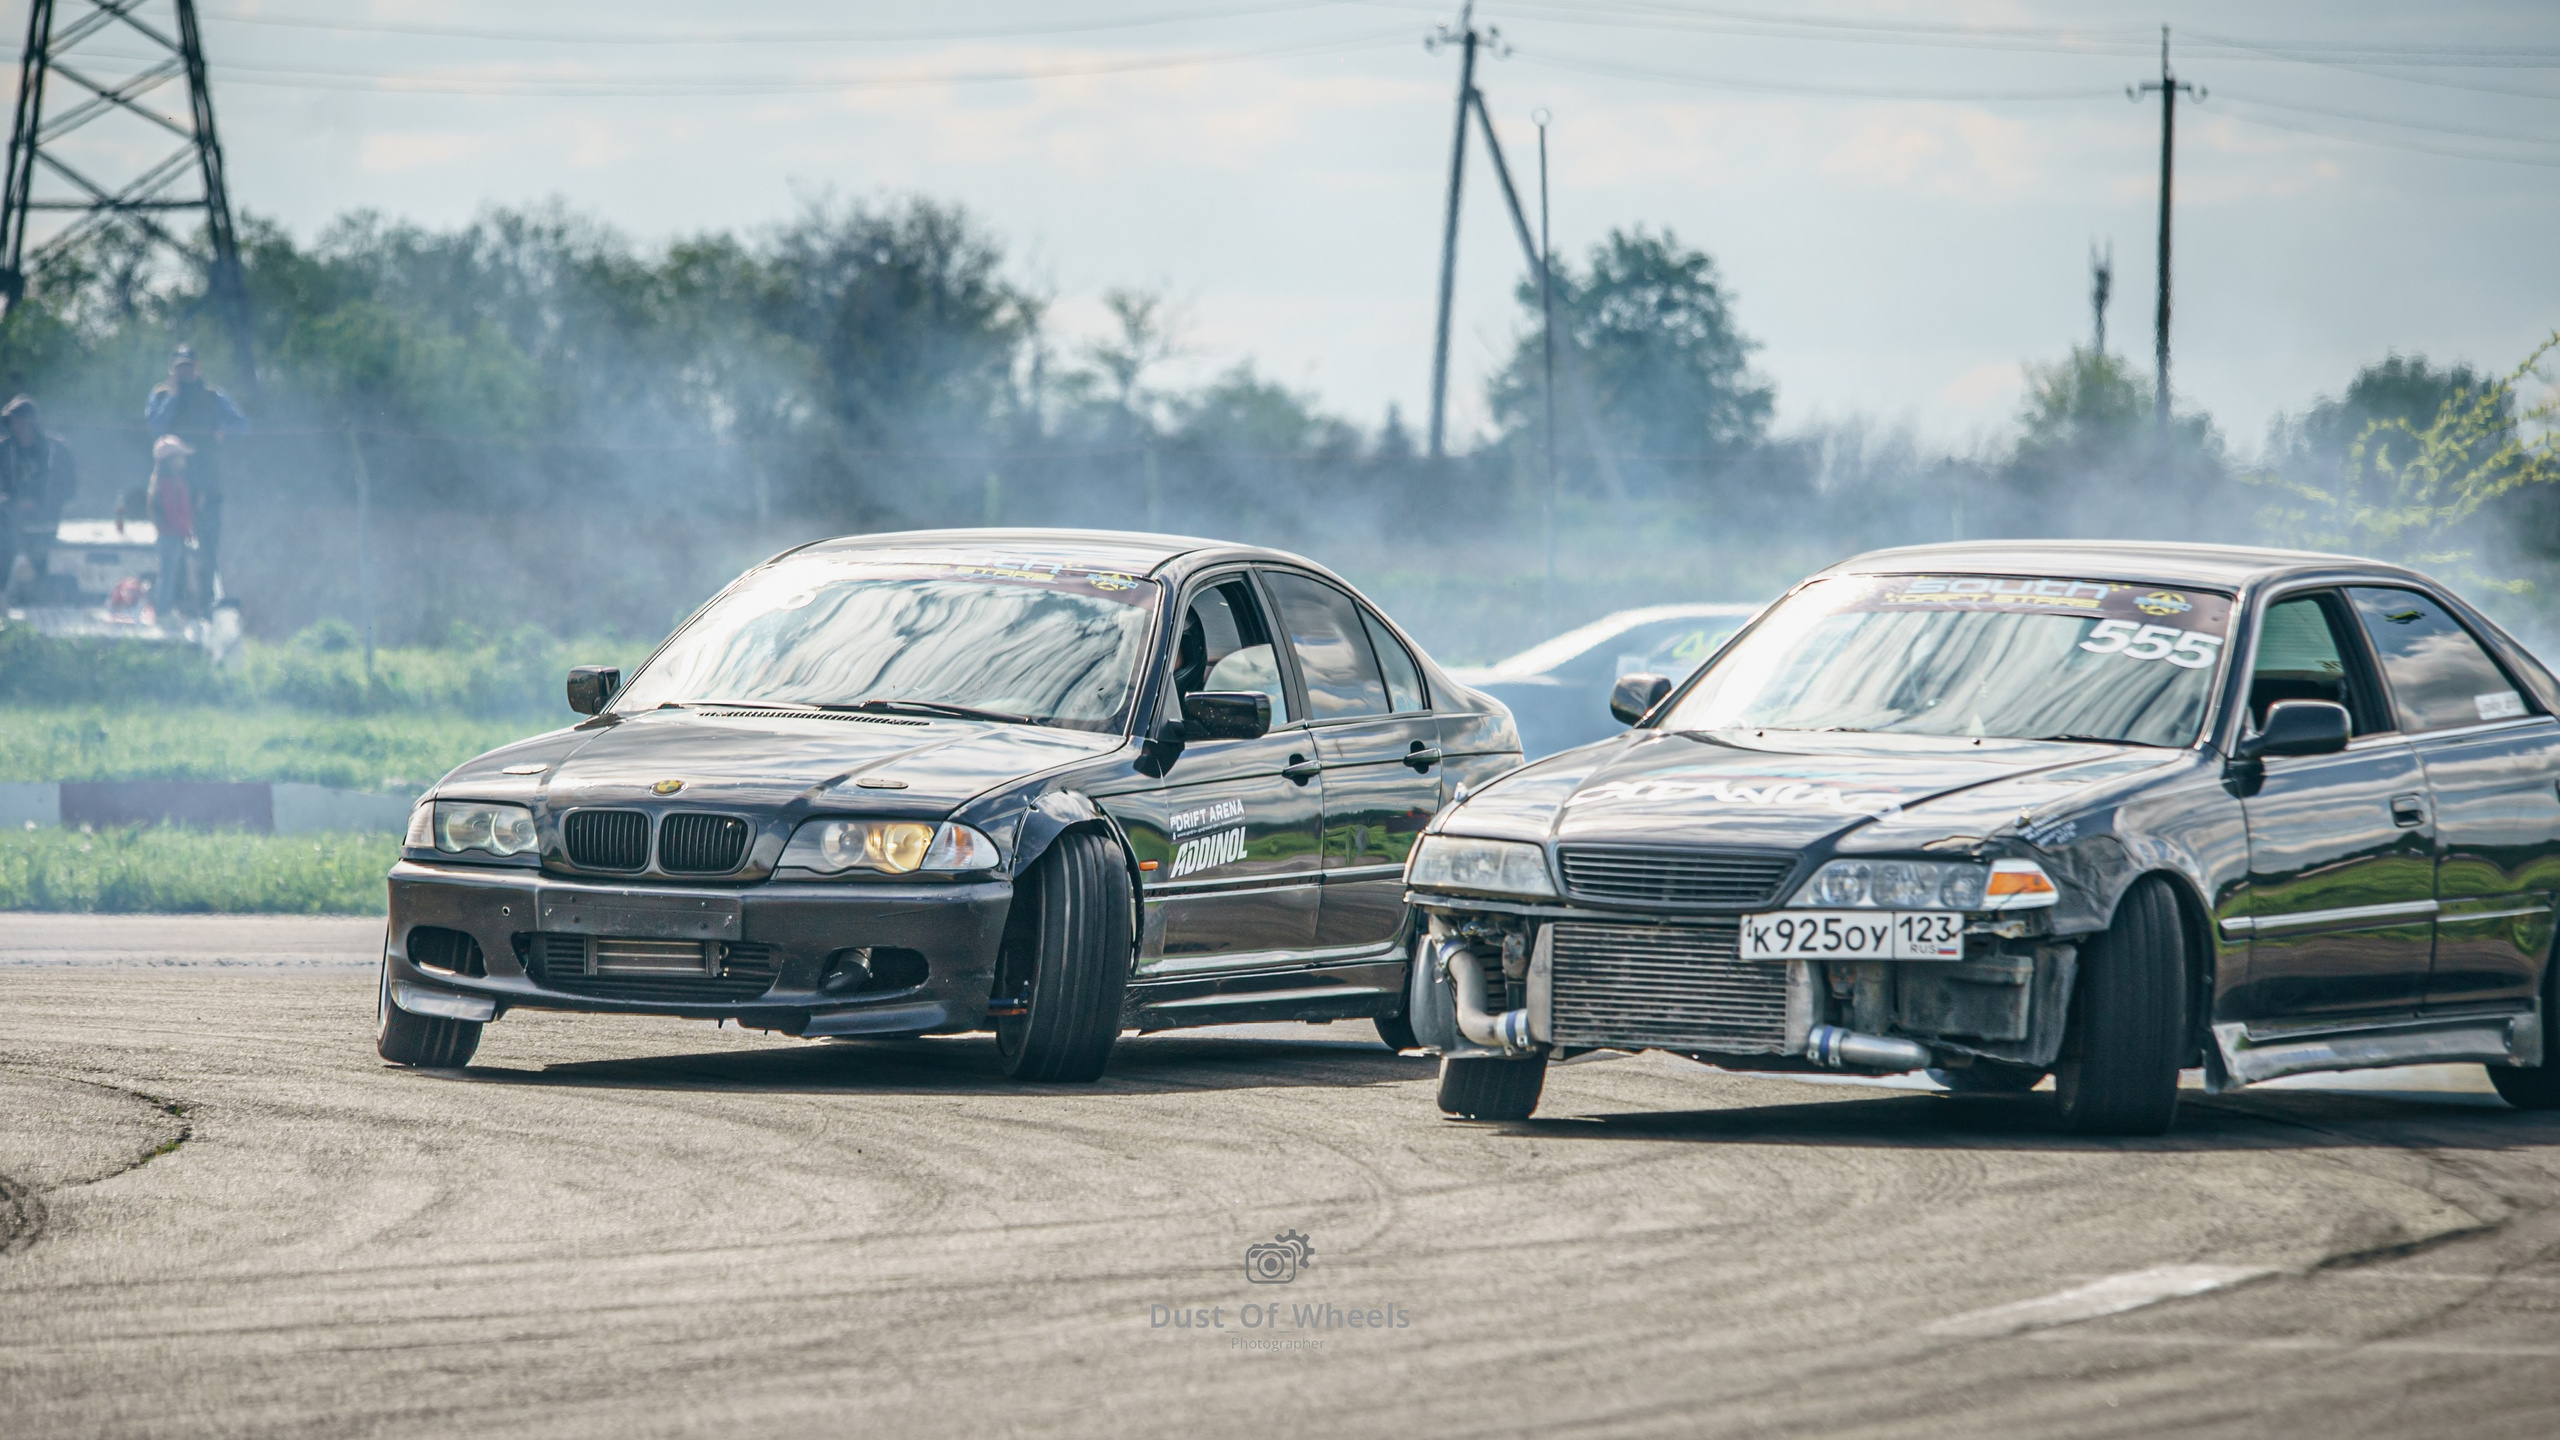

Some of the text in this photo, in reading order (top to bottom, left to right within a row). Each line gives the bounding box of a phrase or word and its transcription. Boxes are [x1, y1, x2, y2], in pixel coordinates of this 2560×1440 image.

[1898, 593, 2101, 609] DRIFT STARS
[2078, 618, 2225, 670] 555
[1175, 808, 1207, 832] DRIFT
[1209, 798, 1245, 823] ARENA
[1169, 826, 1248, 879] ADDINOL
[1899, 915, 1953, 943] 123
[1909, 943, 1936, 955] RUS
